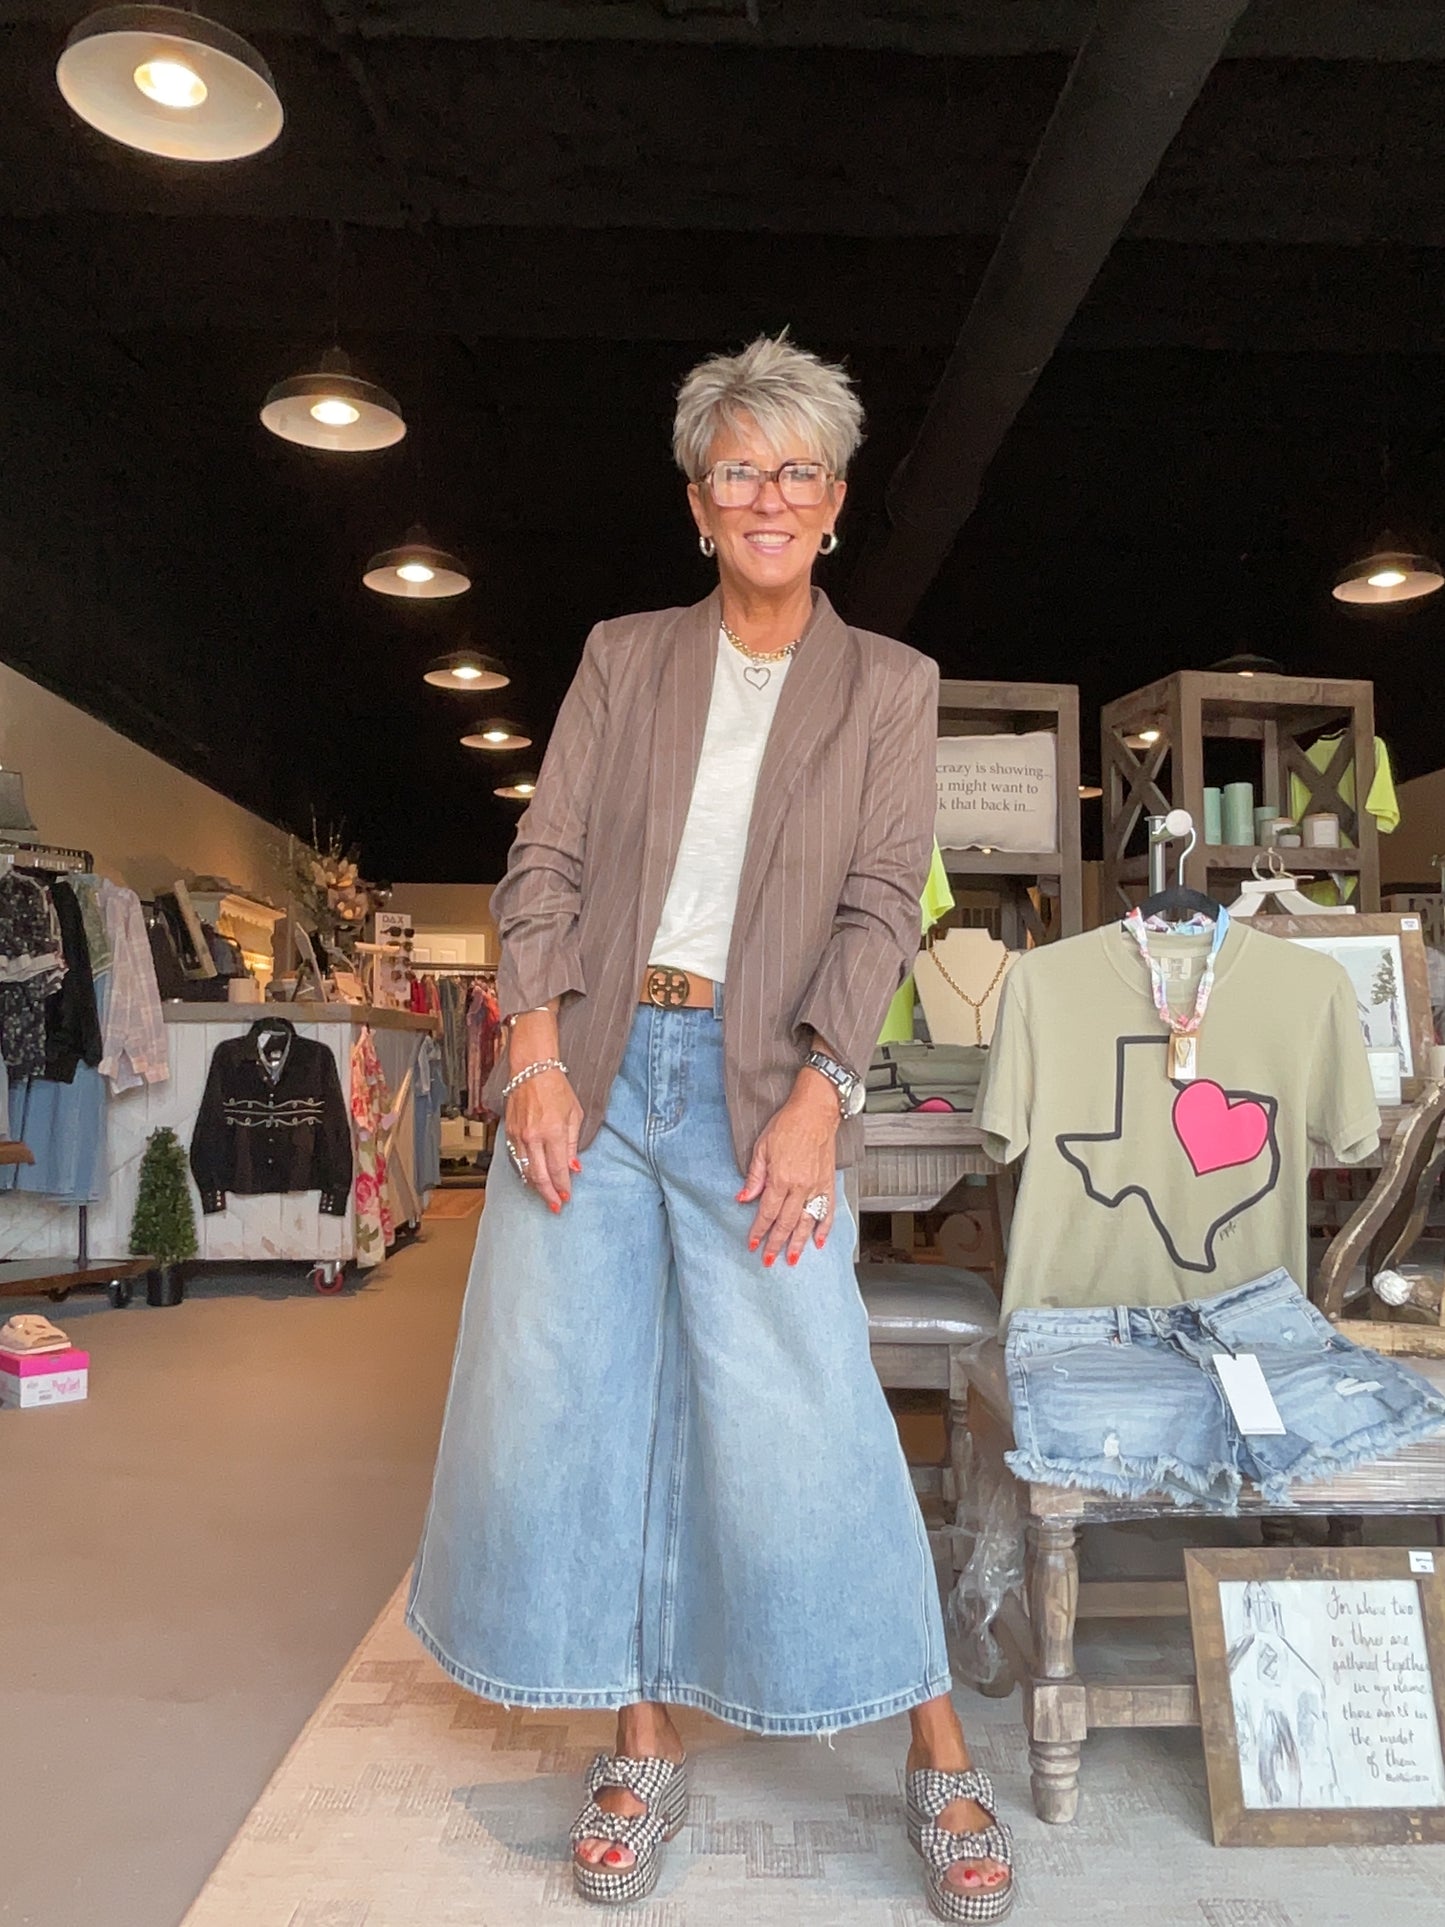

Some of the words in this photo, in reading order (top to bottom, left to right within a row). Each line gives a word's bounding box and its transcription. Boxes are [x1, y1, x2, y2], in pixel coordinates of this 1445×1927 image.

[936, 763, 971, 776] crazy
[976, 762, 986, 774] is
[948, 780, 987, 795] might
[991, 783, 1023, 794] want
[1027, 784, 1039, 794] to
[951, 797, 976, 810] that
[981, 798, 1011, 811] back
[1327, 1586, 1351, 1620] For
[1391, 1596, 1413, 1615] two
[1349, 1727, 1371, 1745] the
[1366, 1751, 1379, 1778] of
[1385, 1749, 1416, 1767] them
